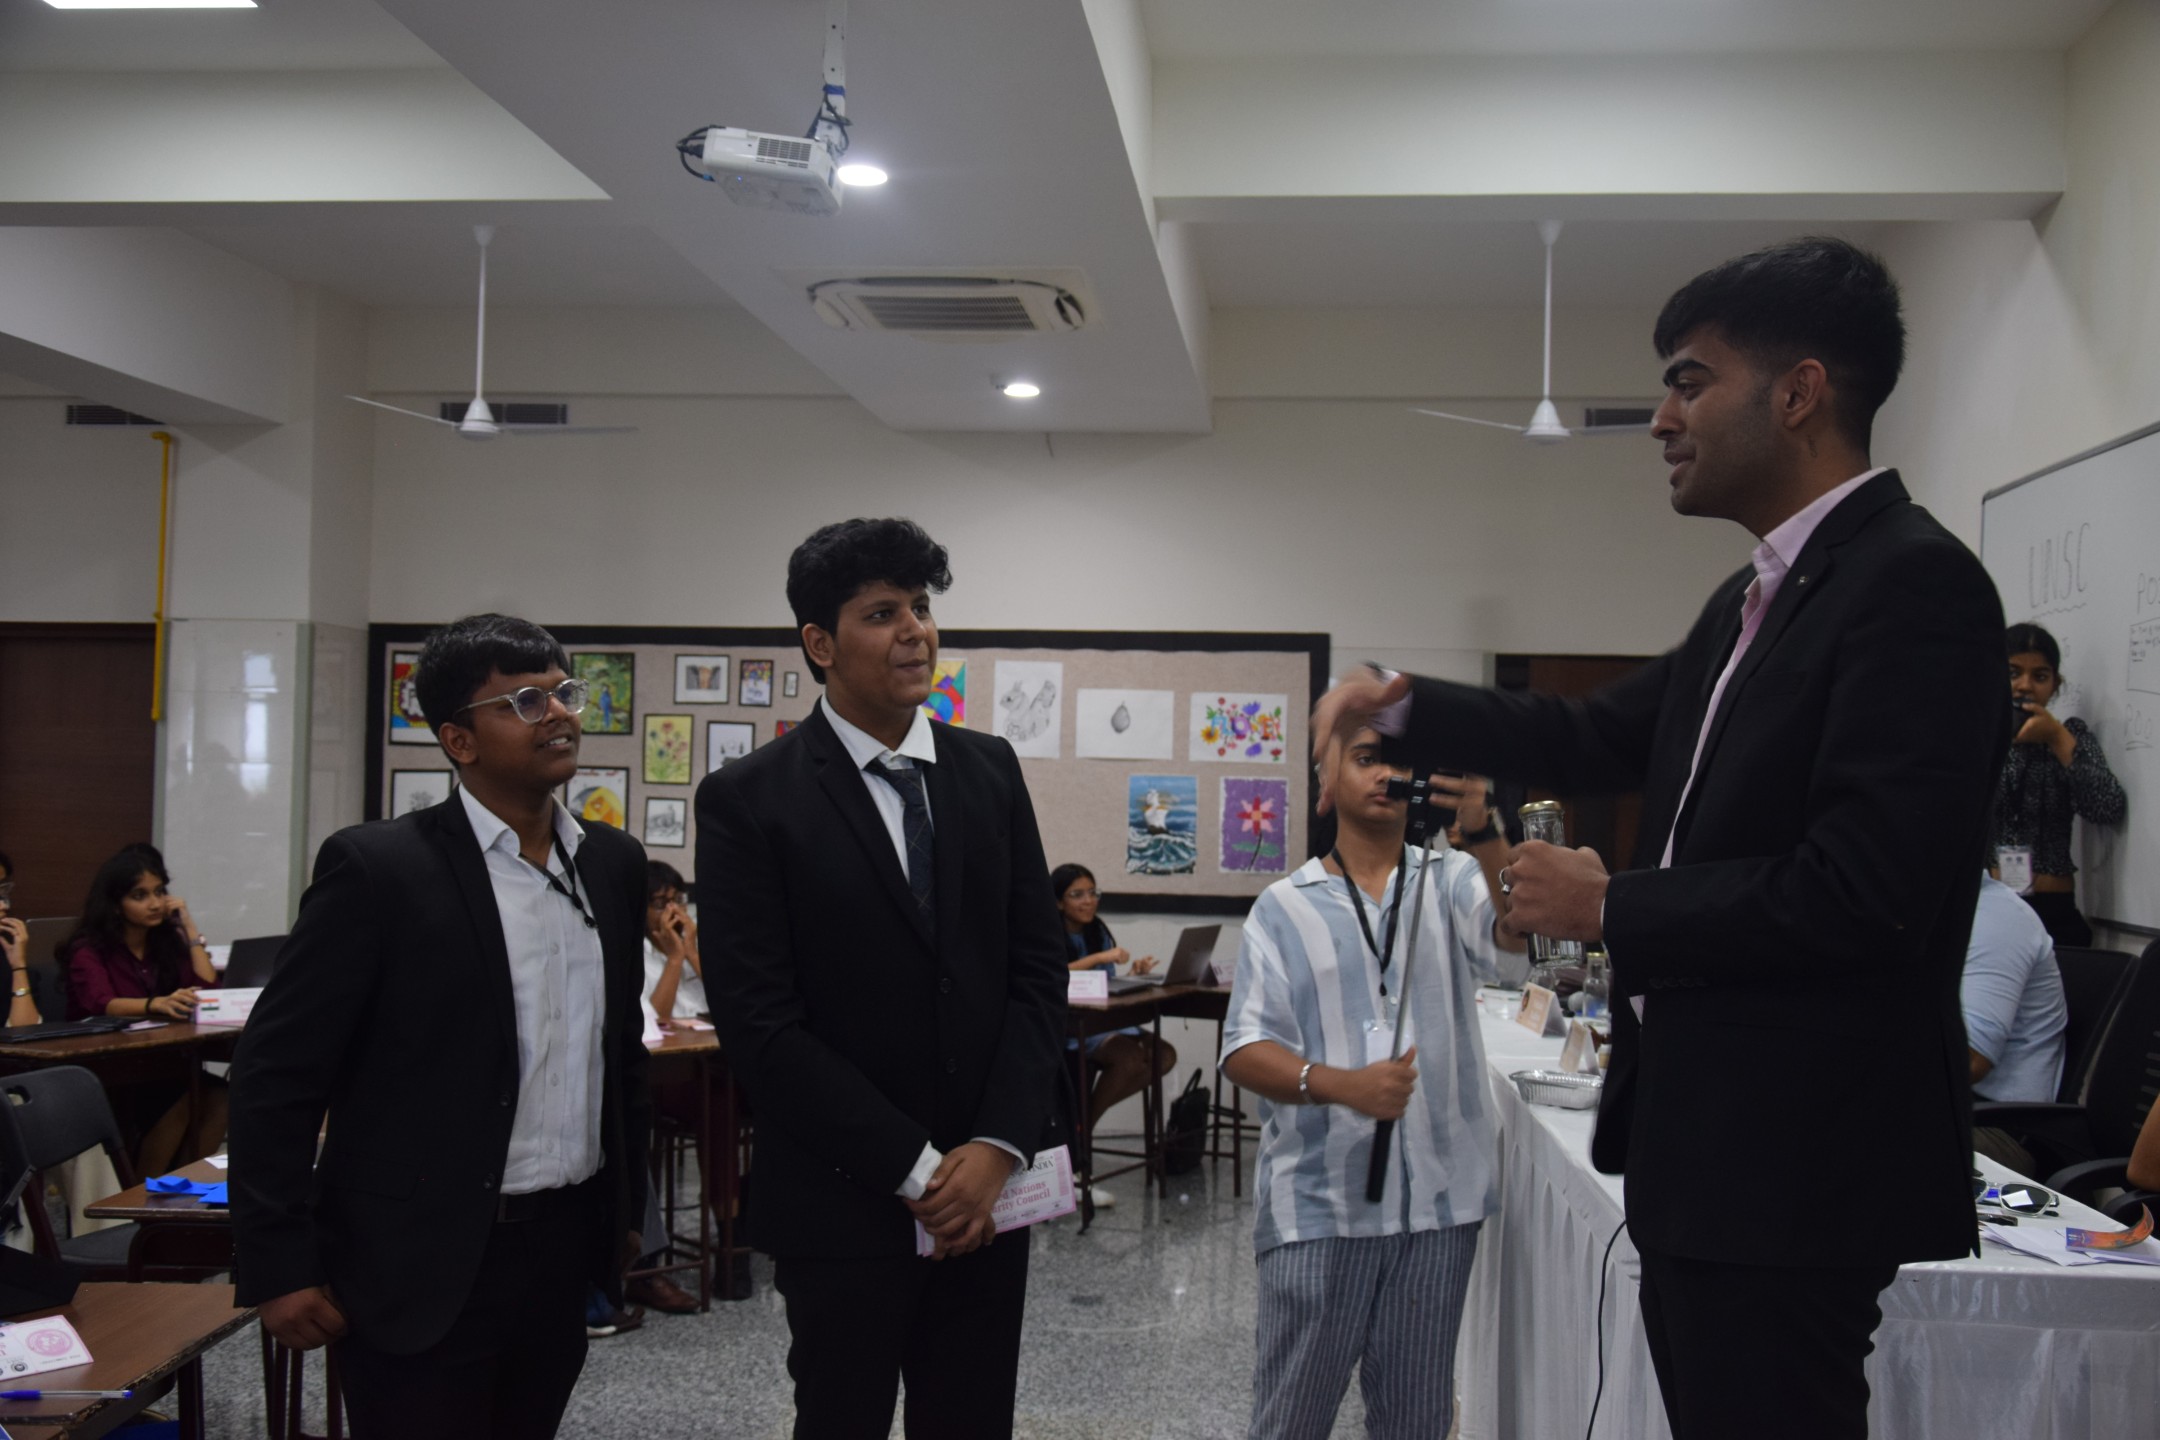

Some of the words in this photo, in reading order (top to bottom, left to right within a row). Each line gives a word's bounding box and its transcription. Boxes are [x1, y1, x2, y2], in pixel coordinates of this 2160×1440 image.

[2028, 522, 2090, 609] UNSC
[2137, 572, 2160, 614] PO
[1011, 1181, 1047, 1197] Nations
[1016, 1188, 1051, 1206] Council
